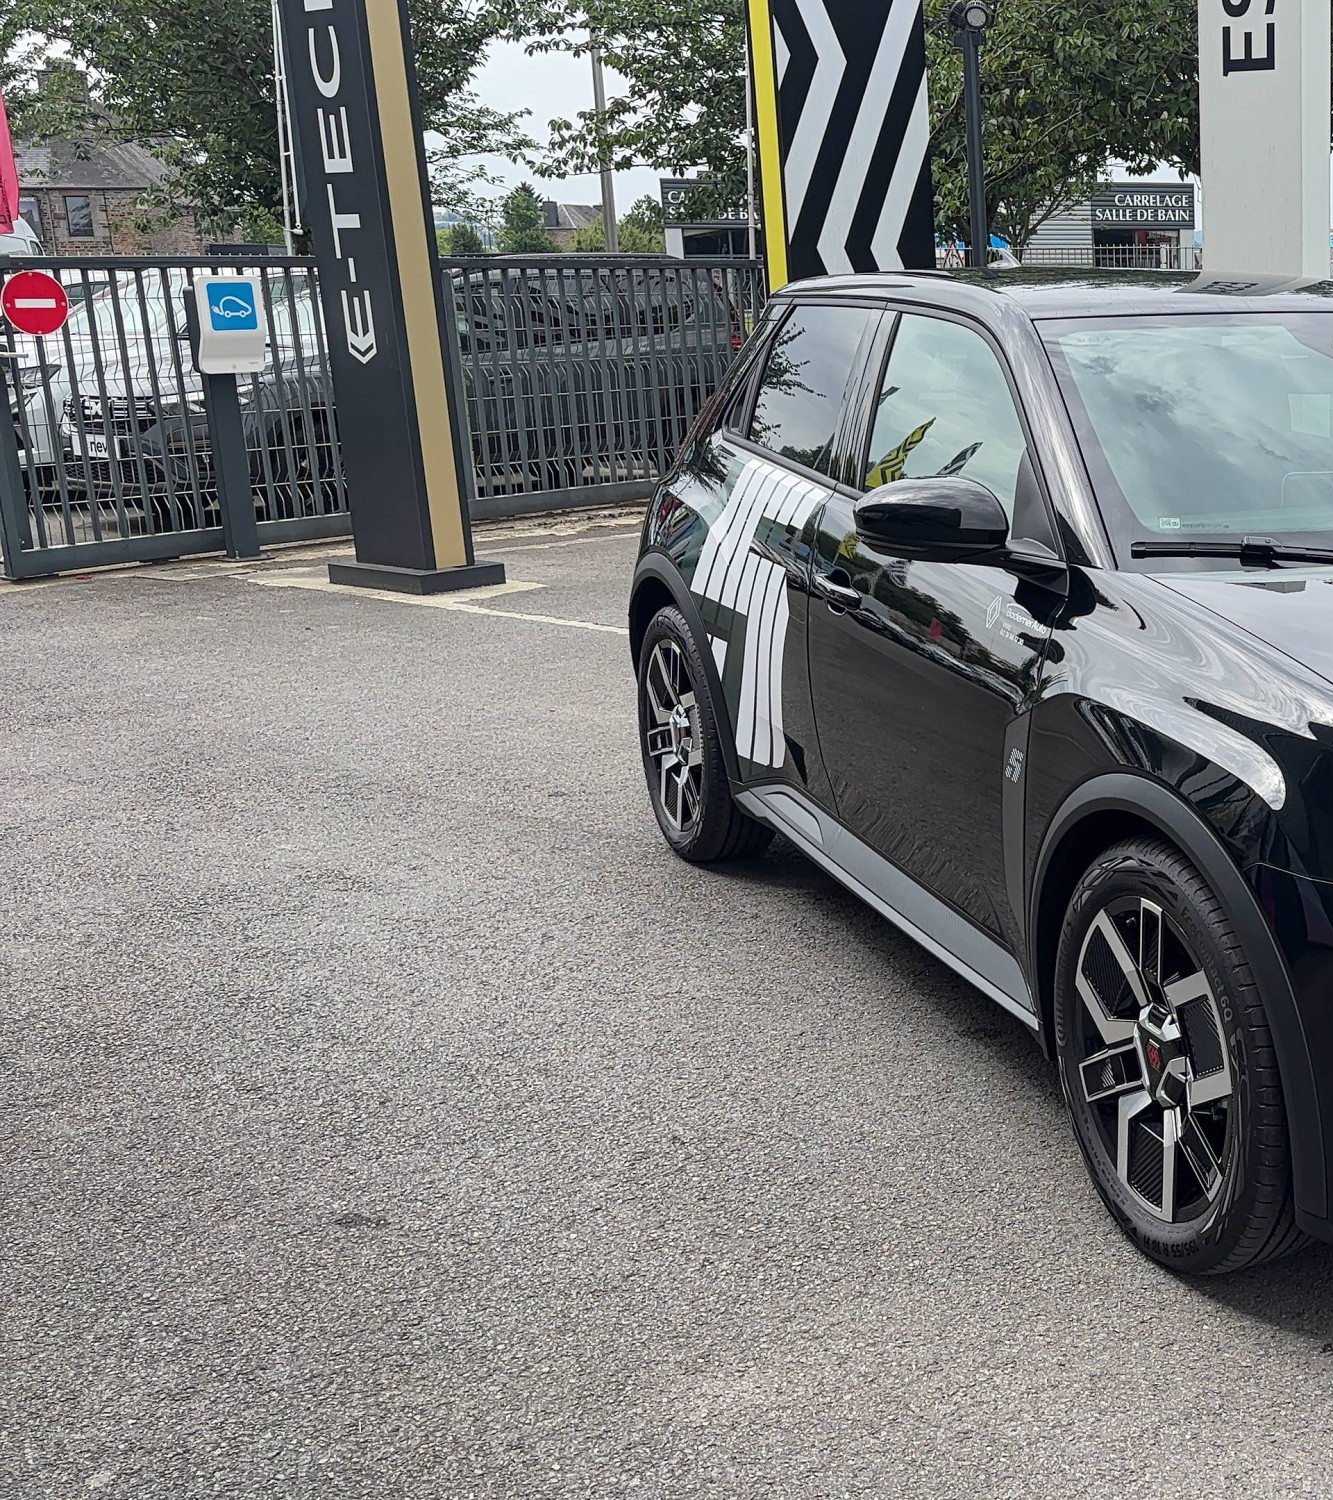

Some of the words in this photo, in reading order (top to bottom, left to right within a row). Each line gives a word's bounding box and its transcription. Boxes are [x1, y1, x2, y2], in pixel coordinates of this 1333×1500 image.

[304, 0, 377, 364] E-TEC
[1114, 194, 1189, 207] CARRELAGE
[1095, 208, 1133, 221] SALLE
[1136, 209, 1154, 221] DE
[1157, 209, 1190, 221] BAIN
[1172, 1238, 1200, 1259] 195/55
